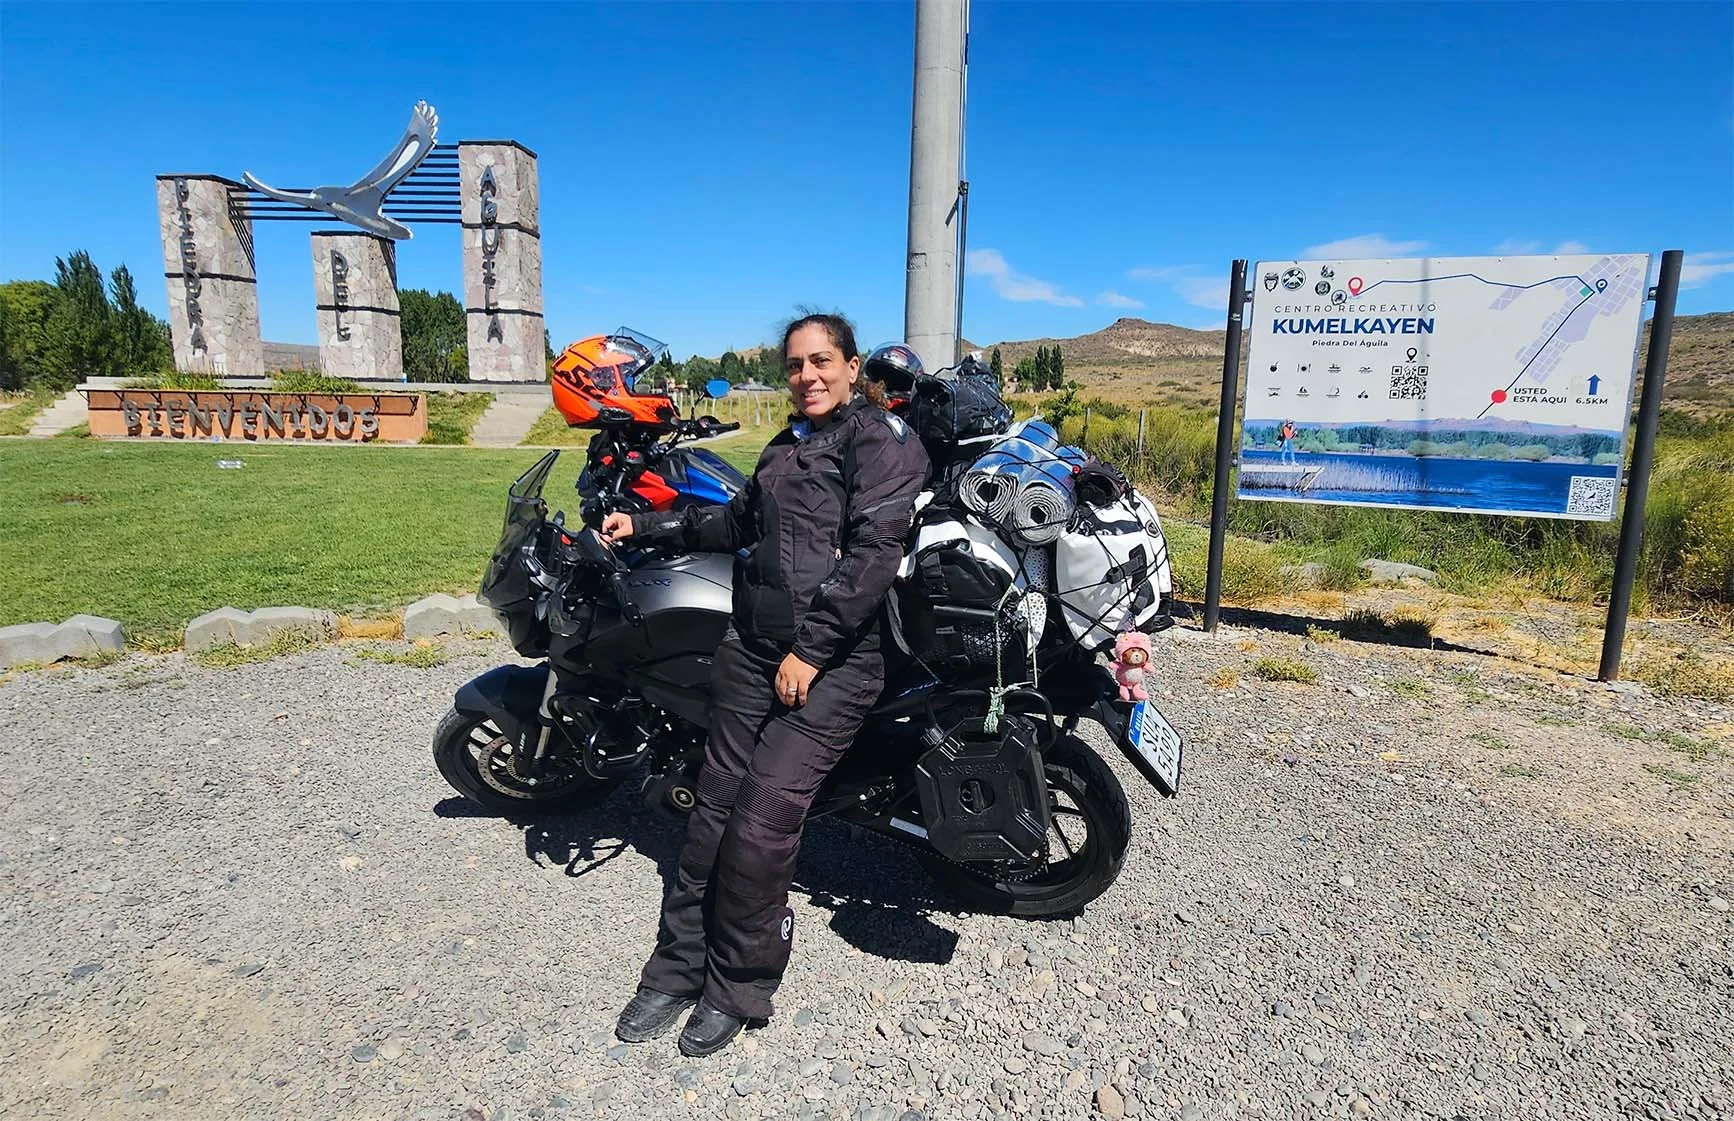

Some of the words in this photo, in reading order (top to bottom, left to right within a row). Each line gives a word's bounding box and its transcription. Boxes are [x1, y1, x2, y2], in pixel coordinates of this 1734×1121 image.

[174, 177, 208, 356] PIEDRA
[330, 249, 351, 342] DEL
[1274, 305, 1332, 313] CENTRO
[1338, 303, 1437, 312] RECREATIVO
[1272, 318, 1435, 334] KUMELKAYEN
[1359, 339, 1388, 348] Águila
[121, 399, 380, 434] BIENVENIDOS
